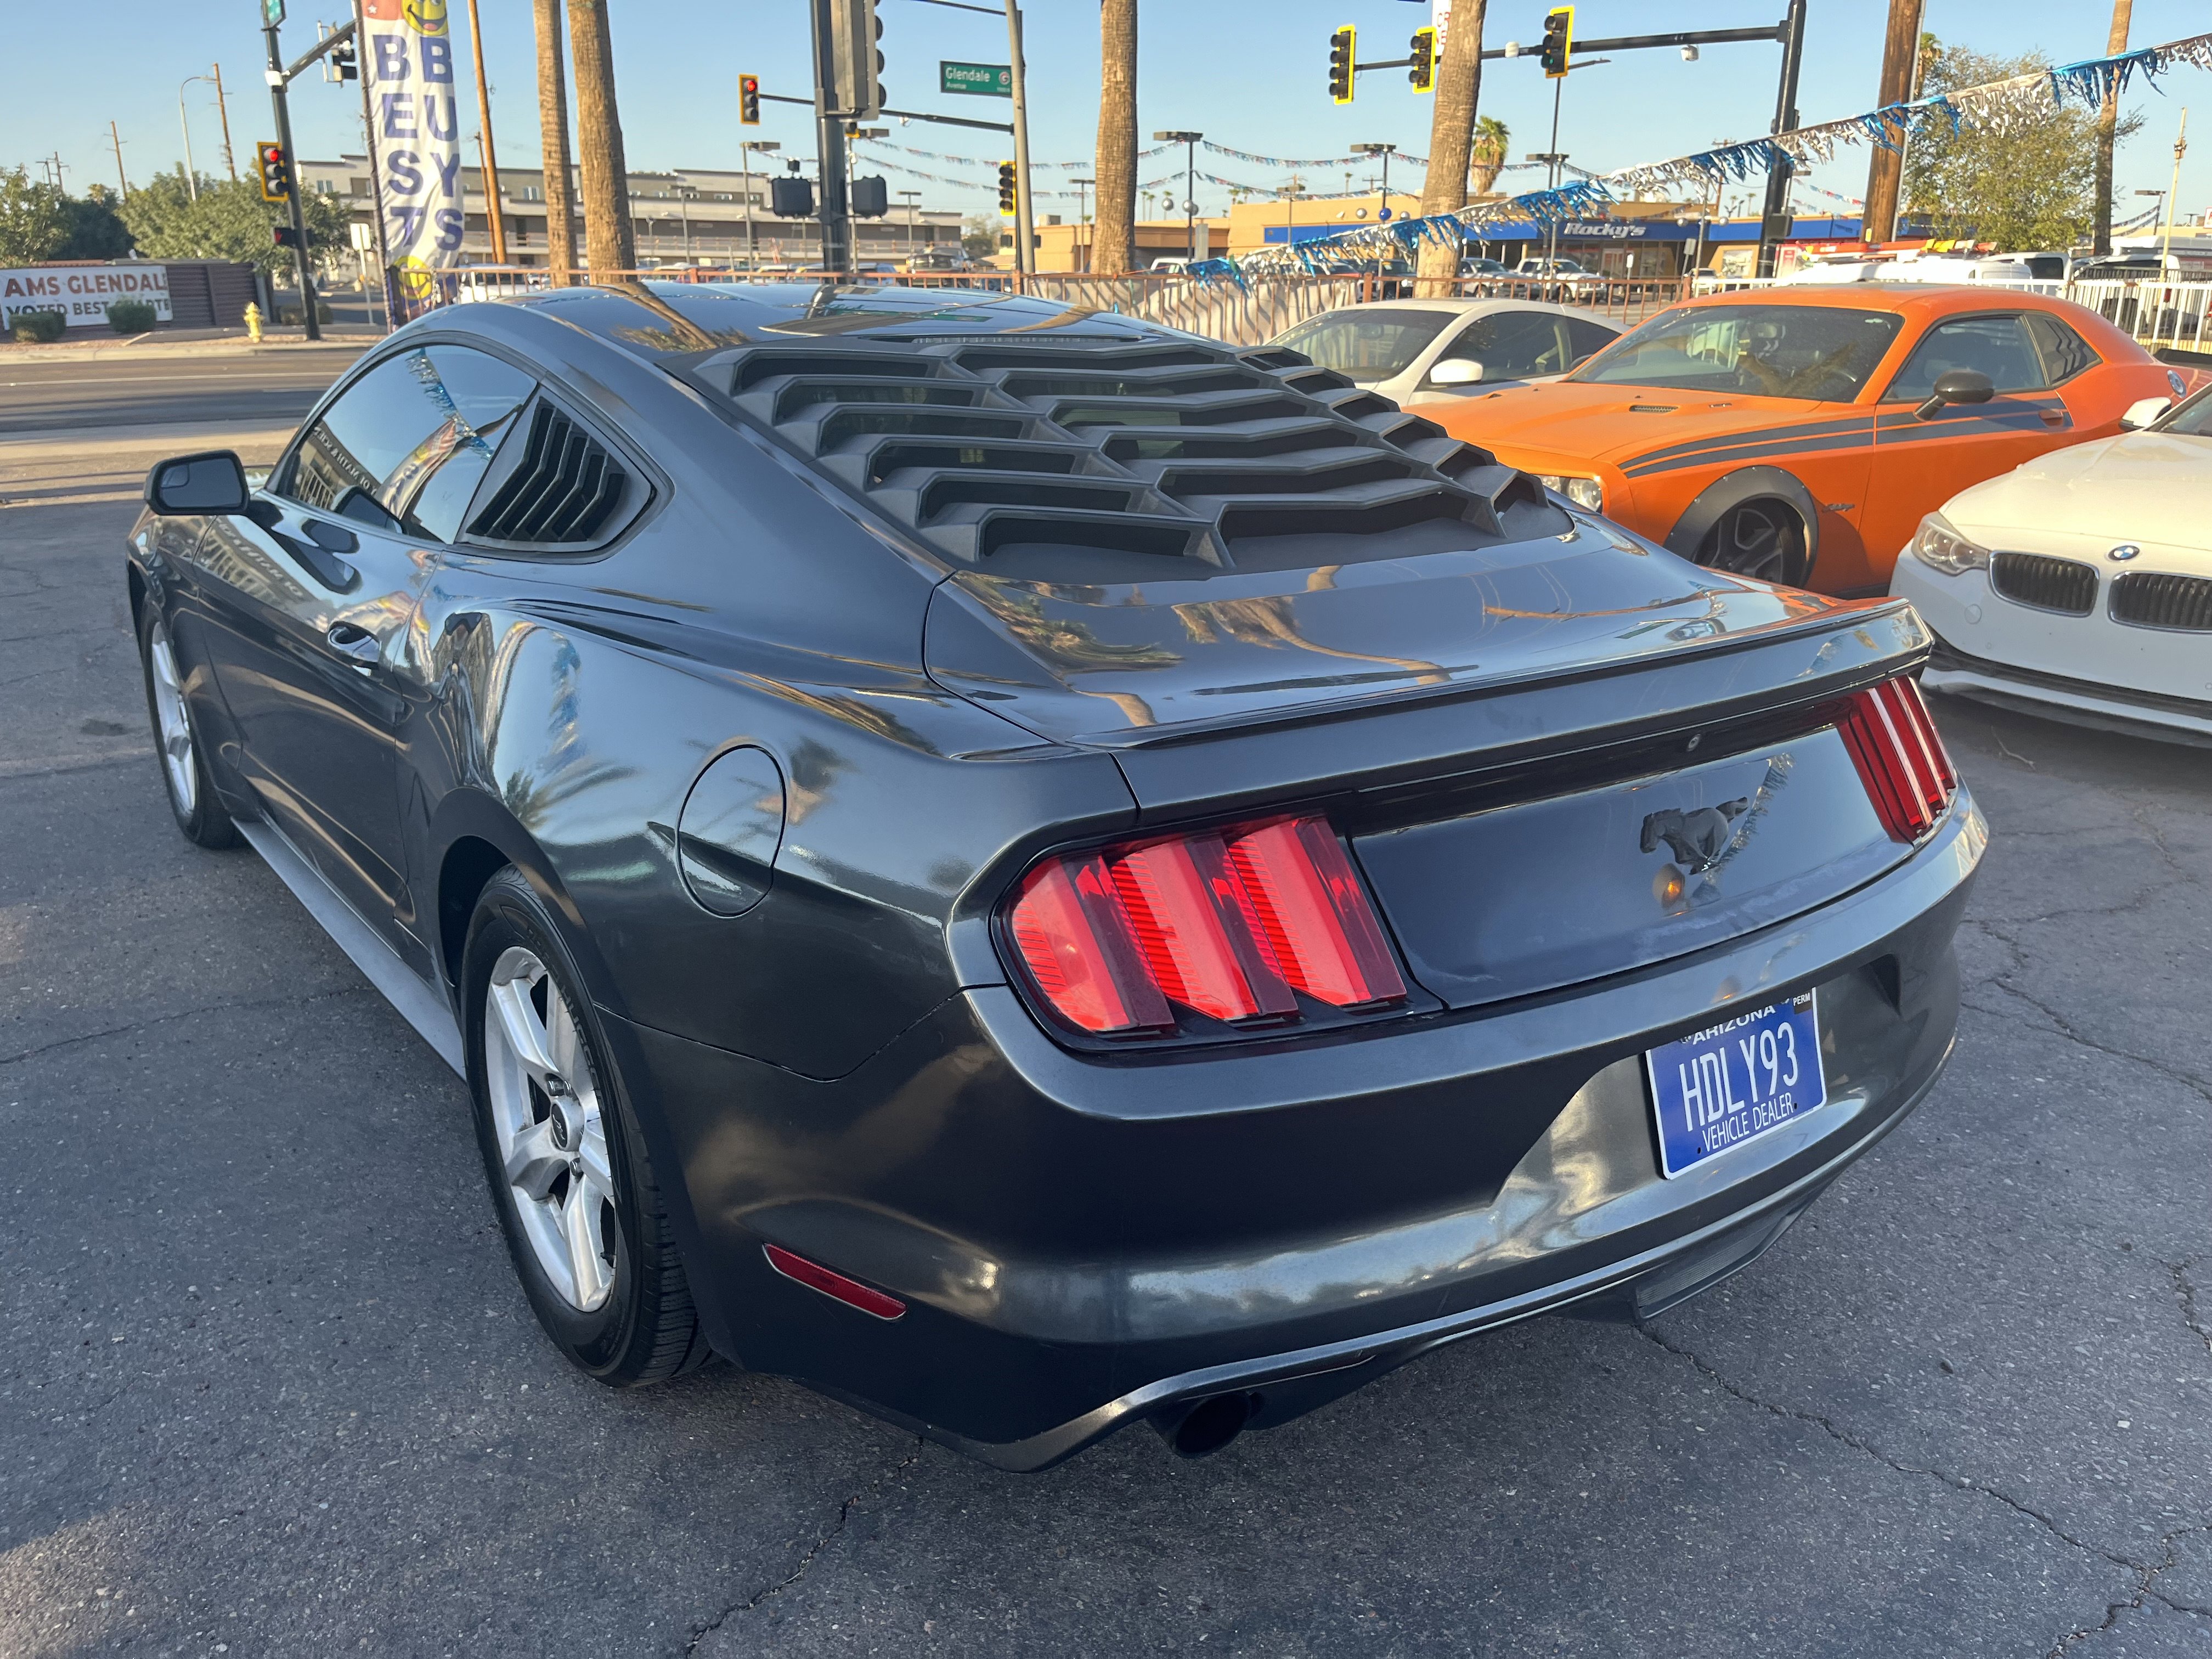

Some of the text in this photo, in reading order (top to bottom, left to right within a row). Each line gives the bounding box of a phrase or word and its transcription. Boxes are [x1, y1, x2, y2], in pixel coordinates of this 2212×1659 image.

[945, 67, 991, 82] Glendale
[371, 34, 423, 246] BEST
[420, 36, 464, 251] BUYS
[1564, 222, 1646, 239] Rocky's
[4, 276, 61, 297] AMS
[73, 301, 110, 315] BEST
[1792, 992, 1811, 1007] PERM
[1692, 1005, 1776, 1045] ARIZONA
[1702, 1092, 1793, 1153] VEHICLE DEALER
